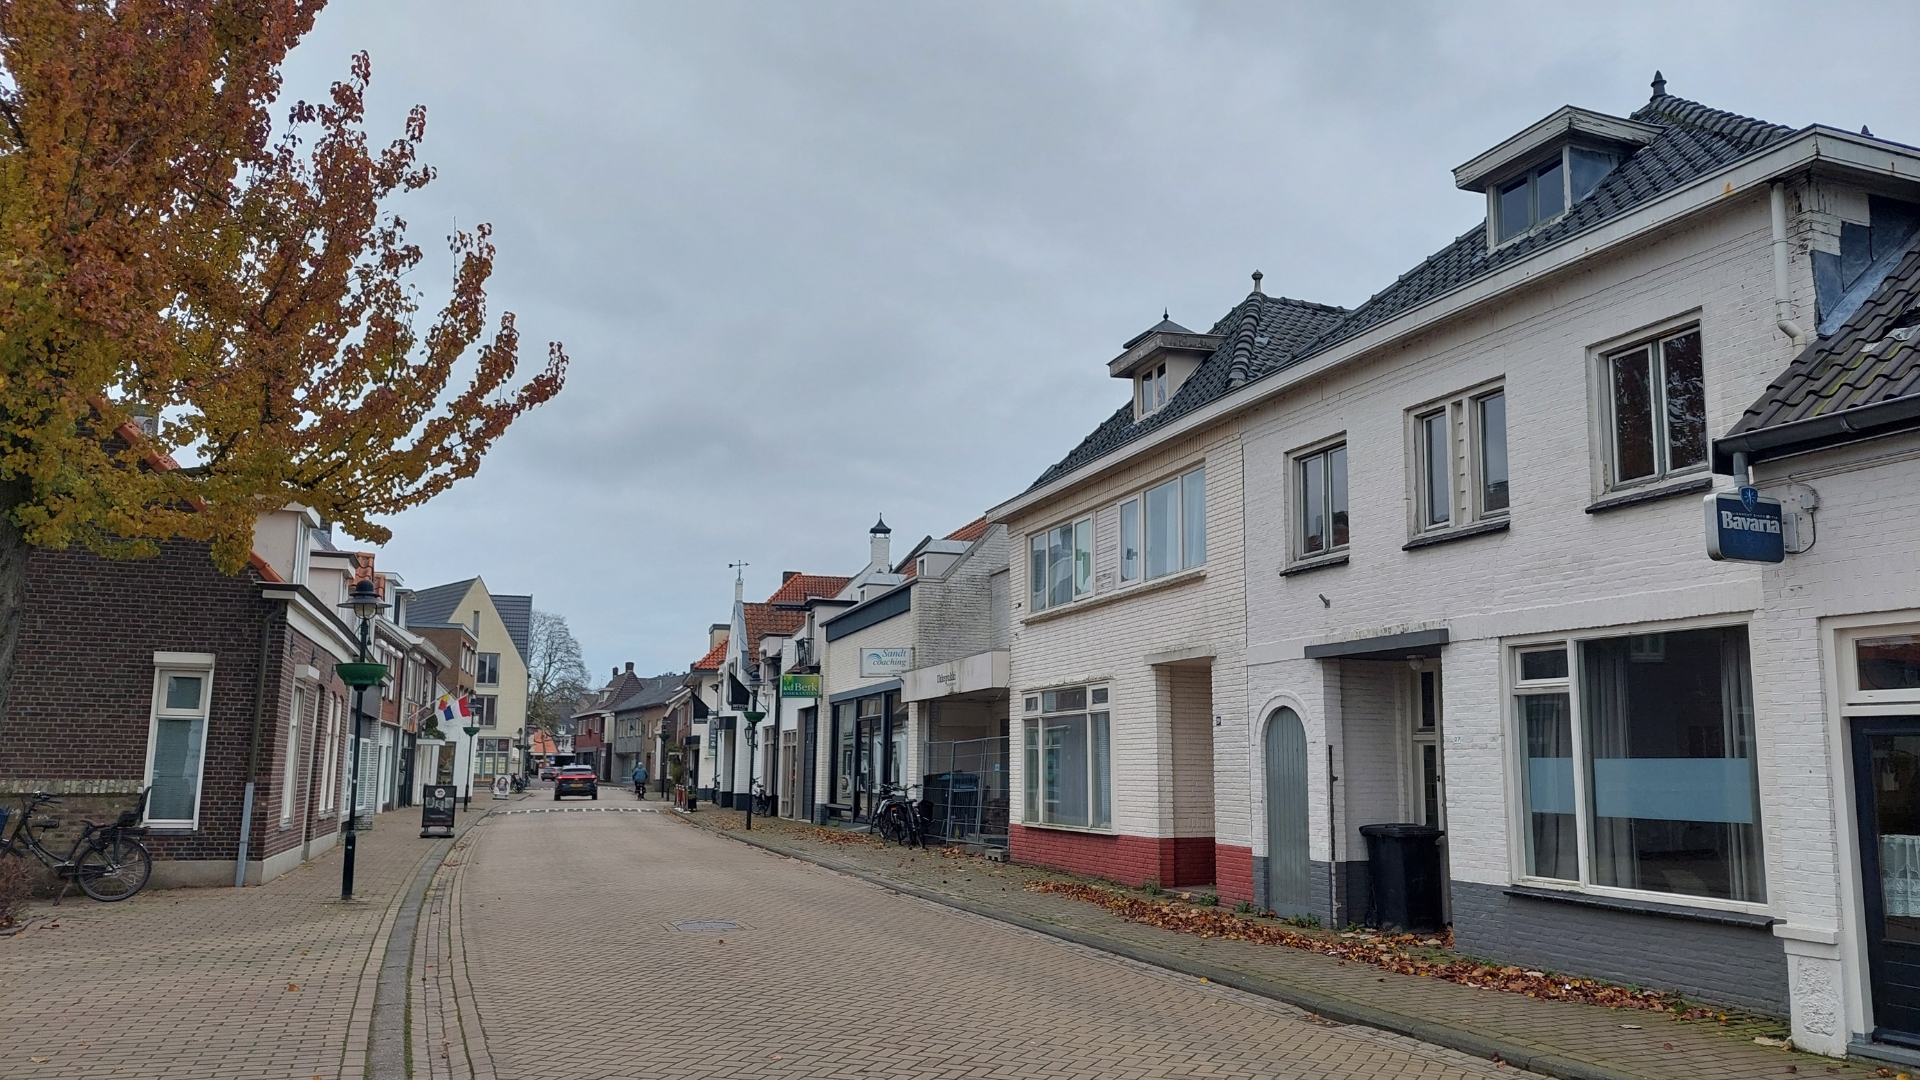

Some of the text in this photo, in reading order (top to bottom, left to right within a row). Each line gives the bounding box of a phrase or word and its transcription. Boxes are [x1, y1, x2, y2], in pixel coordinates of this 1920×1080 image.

[1721, 511, 1781, 534] Bavaria
[882, 649, 907, 658] Sandt
[872, 658, 907, 667] coaching
[794, 682, 818, 691] Berk
